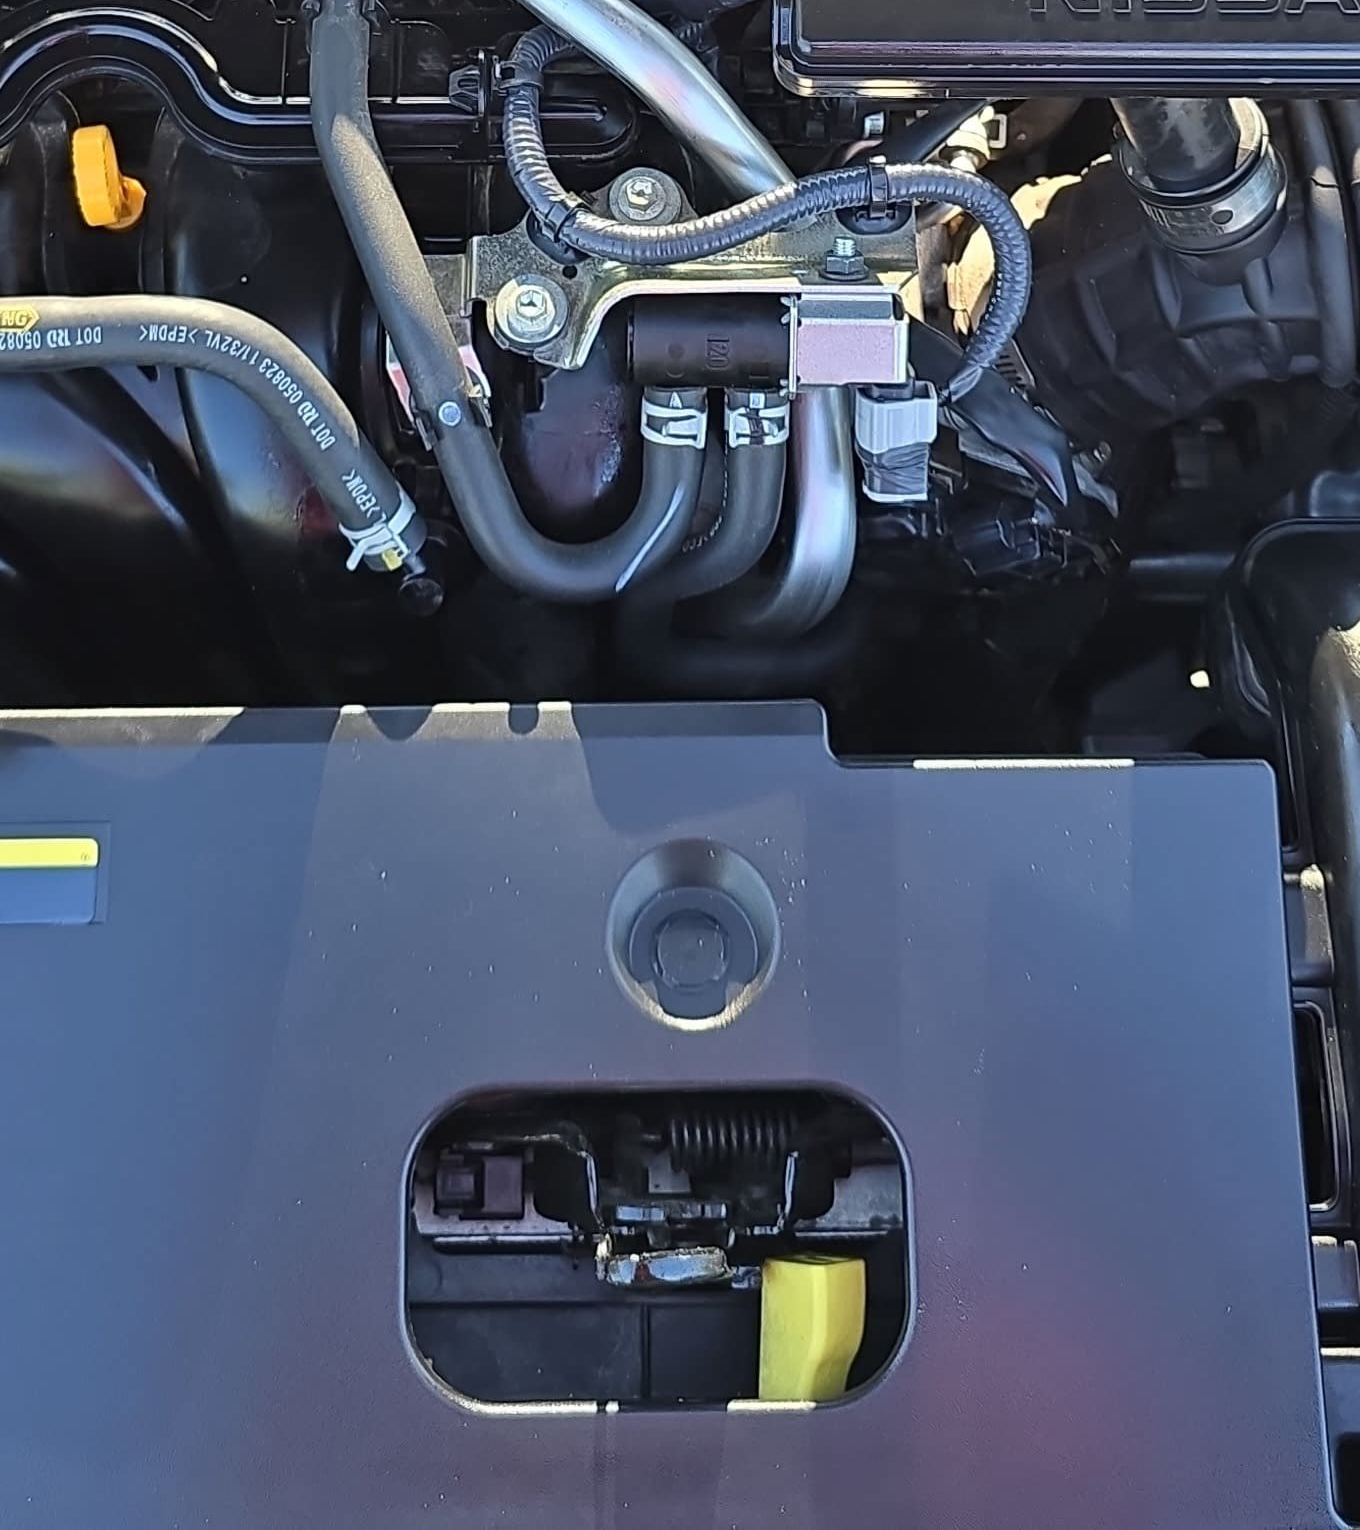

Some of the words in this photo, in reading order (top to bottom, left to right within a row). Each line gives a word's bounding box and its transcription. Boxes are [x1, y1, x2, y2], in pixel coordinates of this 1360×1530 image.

[75, 326, 102, 345] DOT
[139, 324, 197, 344] >EPDM<
[258, 357, 303, 405] 050823
[310, 425, 336, 452] DOT
[341, 469, 381, 518] >EPDM<
